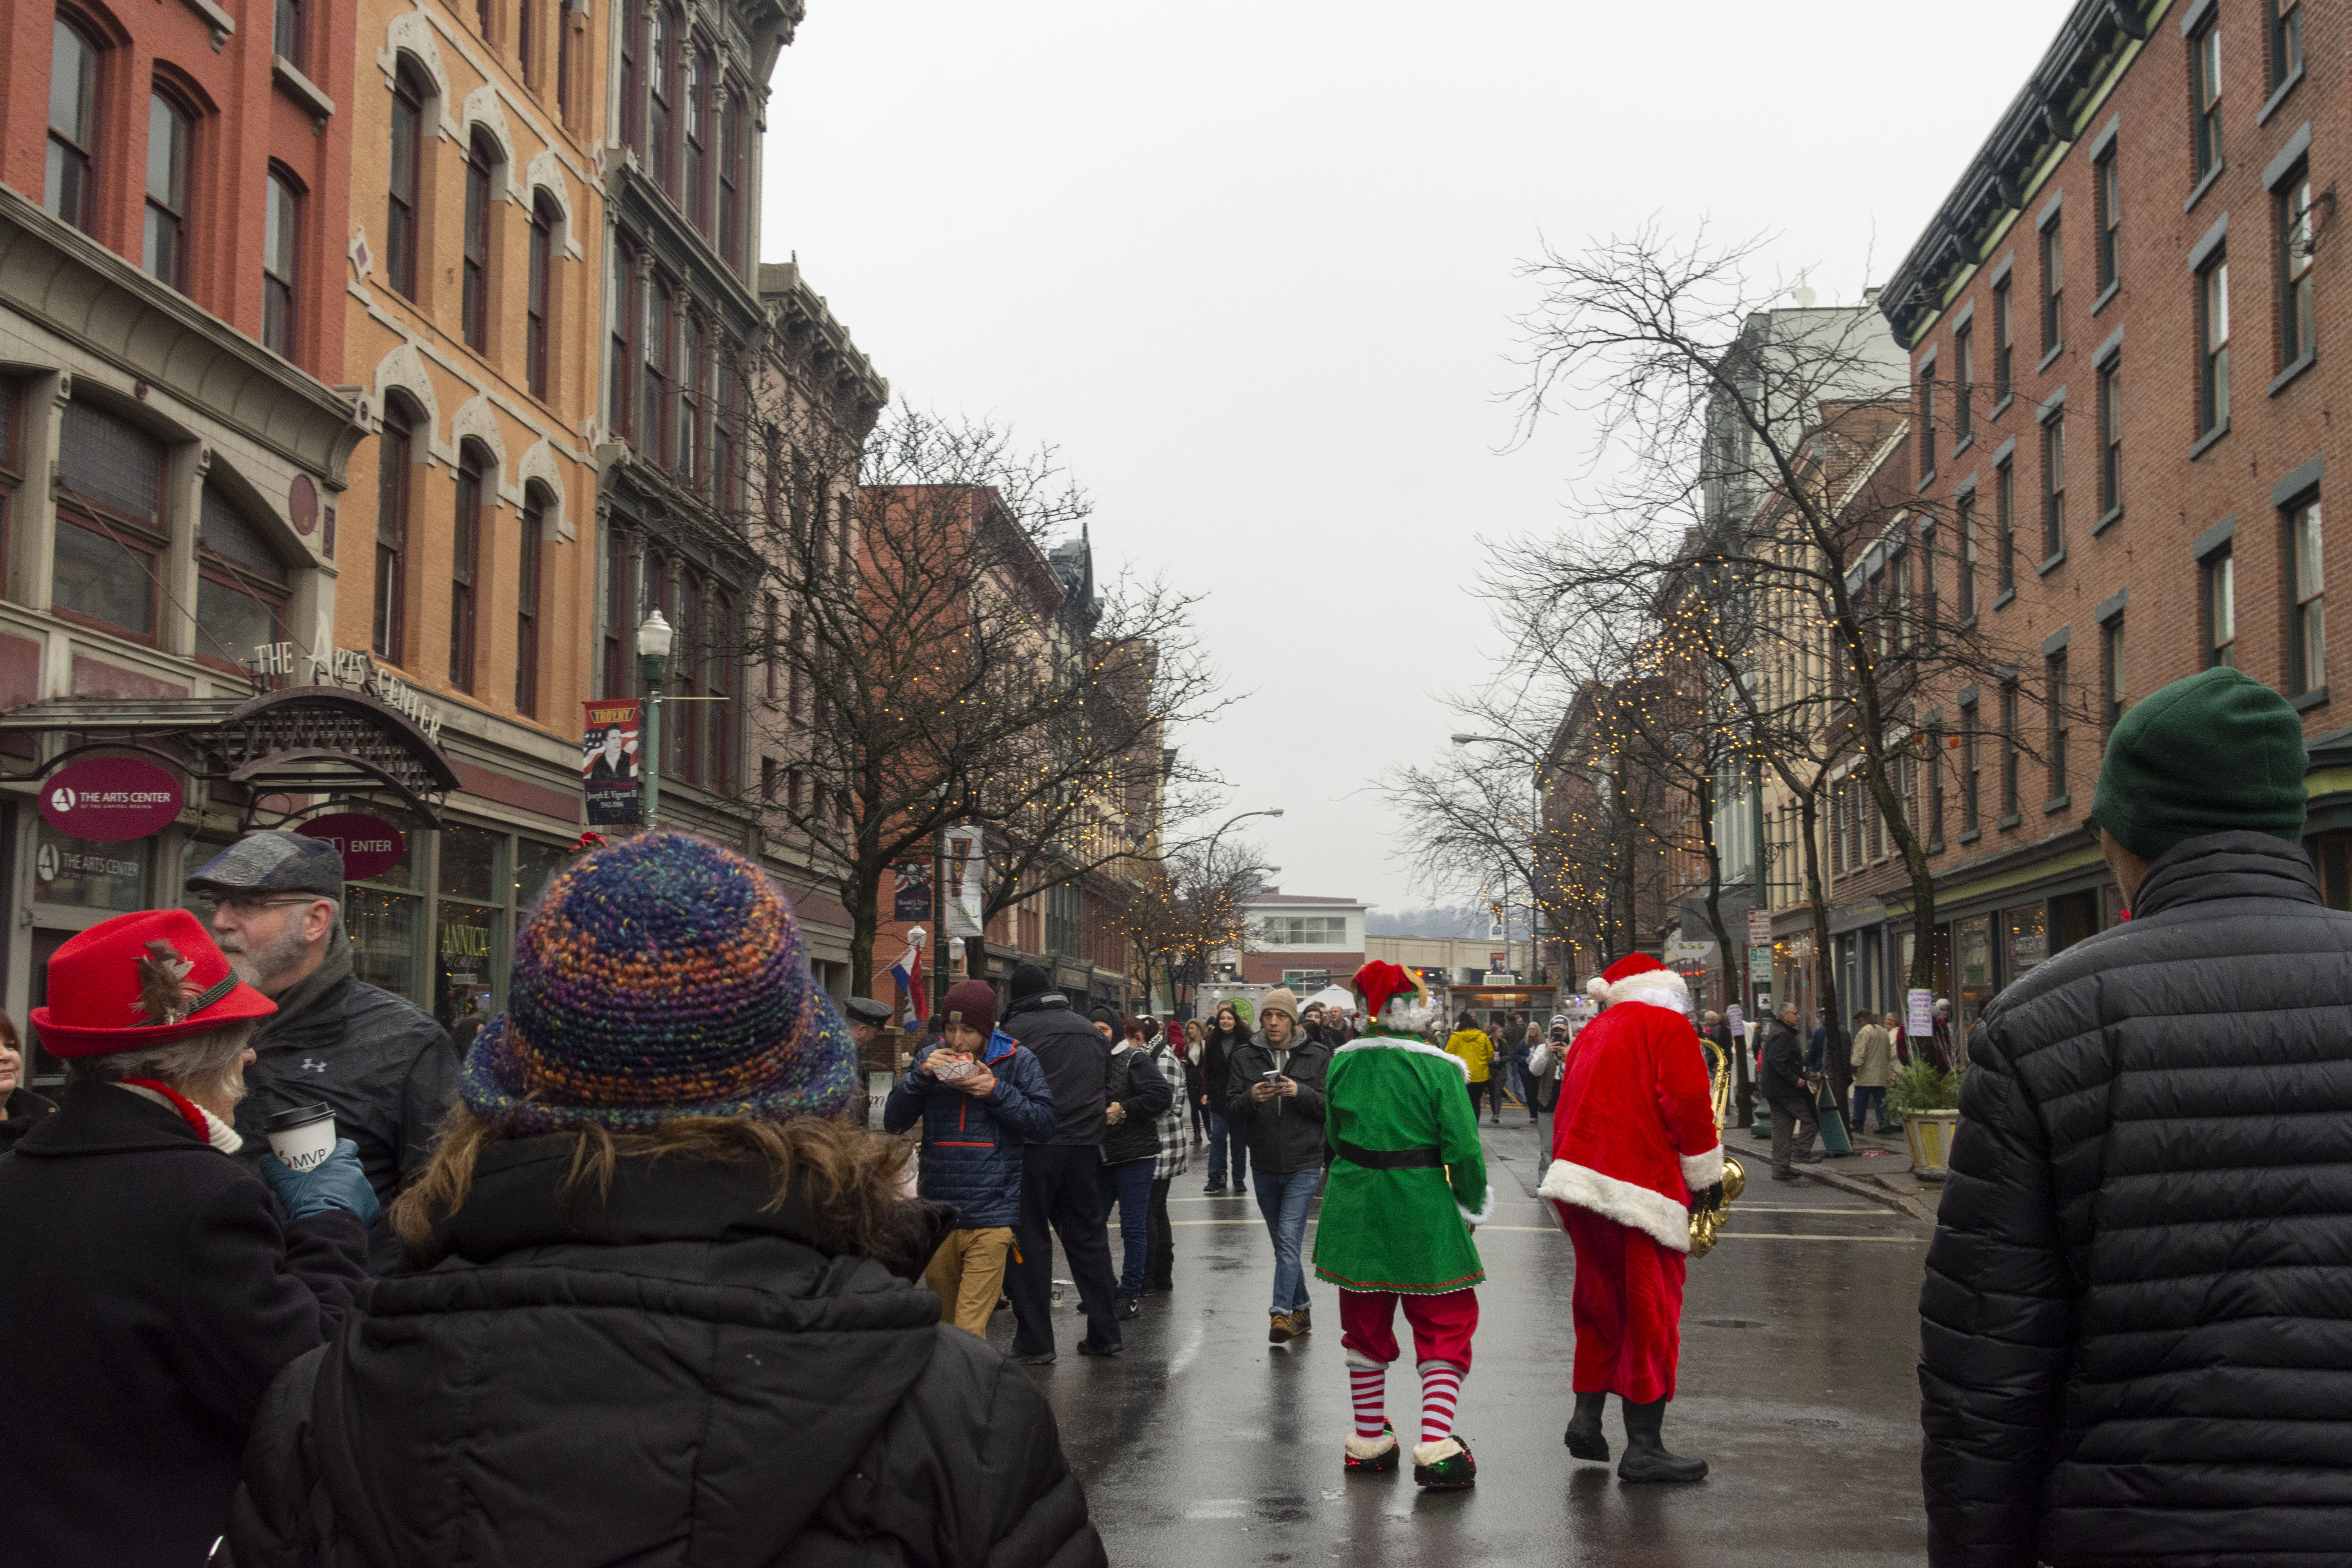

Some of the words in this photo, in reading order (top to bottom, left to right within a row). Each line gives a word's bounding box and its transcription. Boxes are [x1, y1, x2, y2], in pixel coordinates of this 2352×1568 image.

[254, 642, 293, 675] THE
[305, 610, 366, 686] ARTS
[377, 668, 440, 745] CENTER
[80, 792, 101, 802] THE
[102, 792, 129, 802] ARTS
[130, 792, 171, 802] CENTER
[351, 840, 392, 852] ENTER
[63, 853, 81, 869] THE
[82, 856, 105, 873] ARTS
[293, 1149, 325, 1168] MVP
